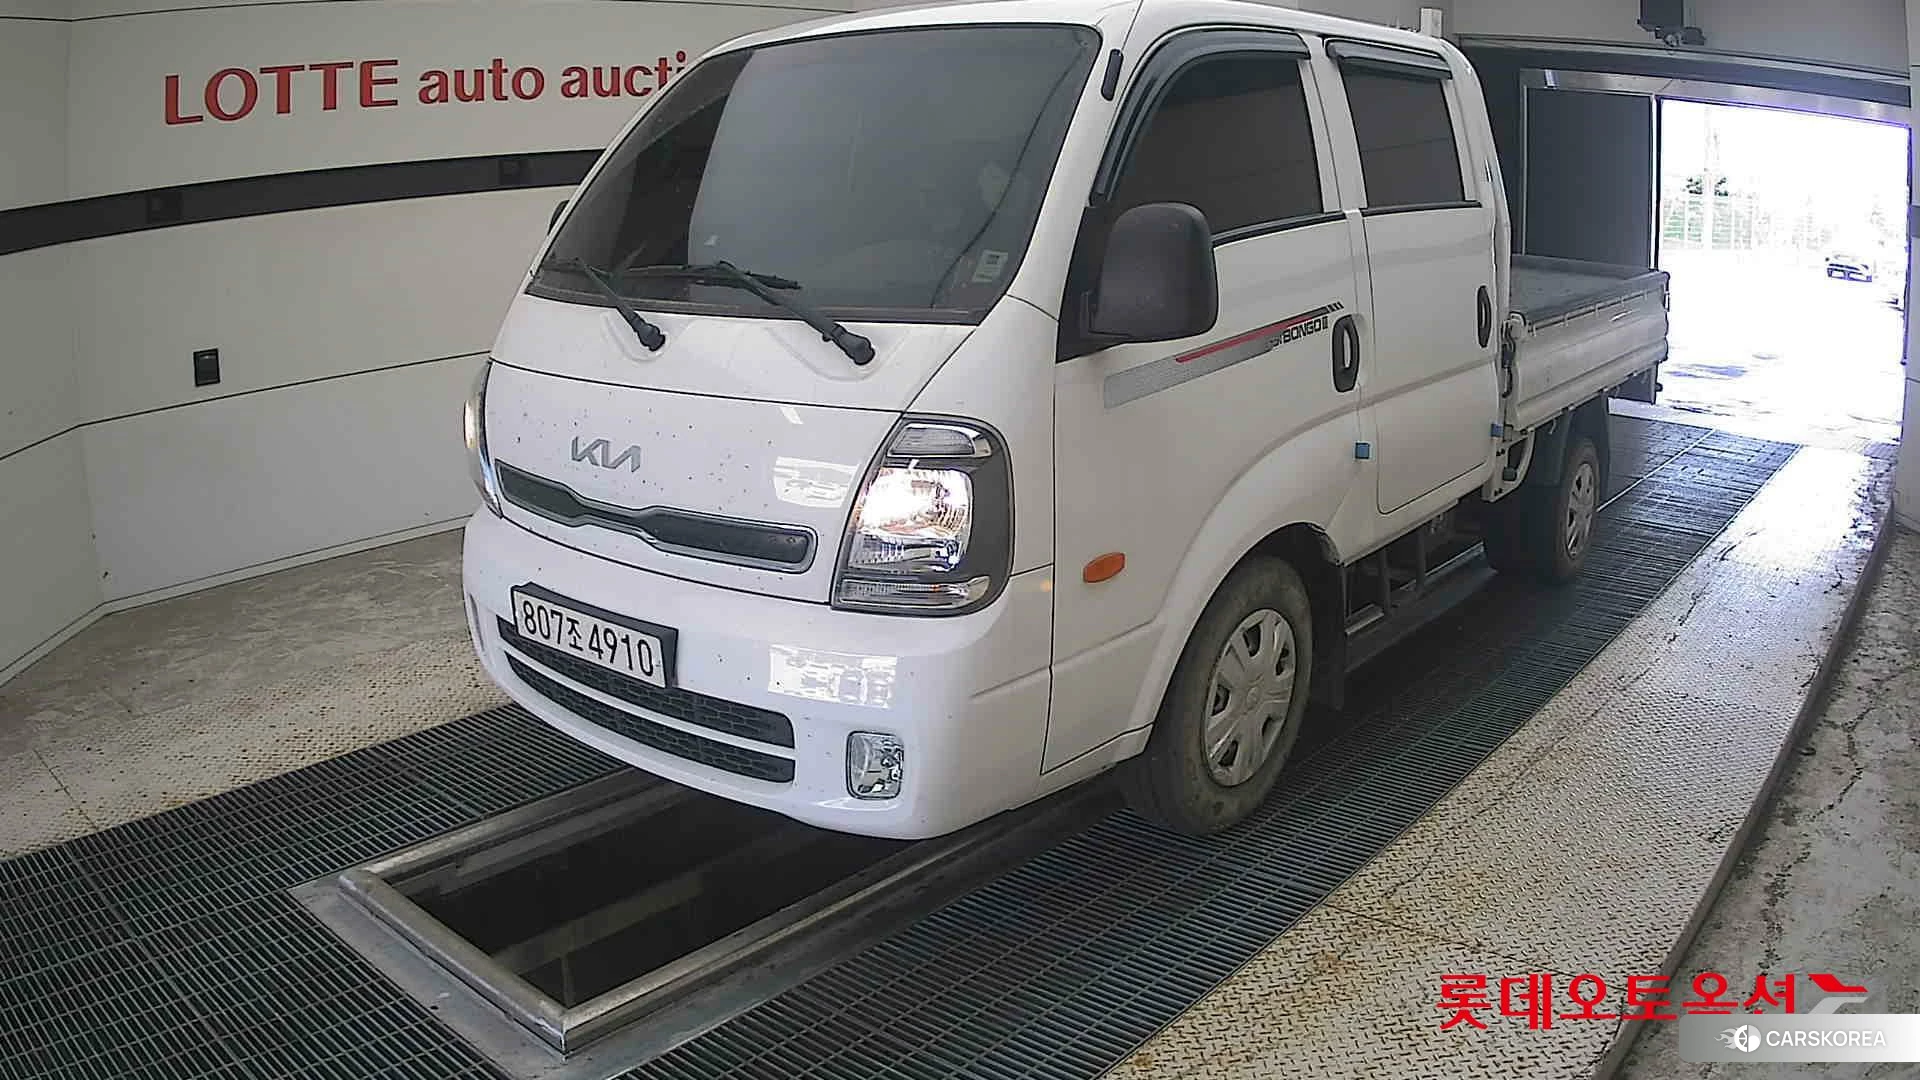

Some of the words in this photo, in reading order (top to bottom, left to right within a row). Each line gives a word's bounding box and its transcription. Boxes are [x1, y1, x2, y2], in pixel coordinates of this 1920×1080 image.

[164, 59, 400, 125] LOTTE
[418, 58, 545, 104] auto
[571, 436, 642, 473] KIA
